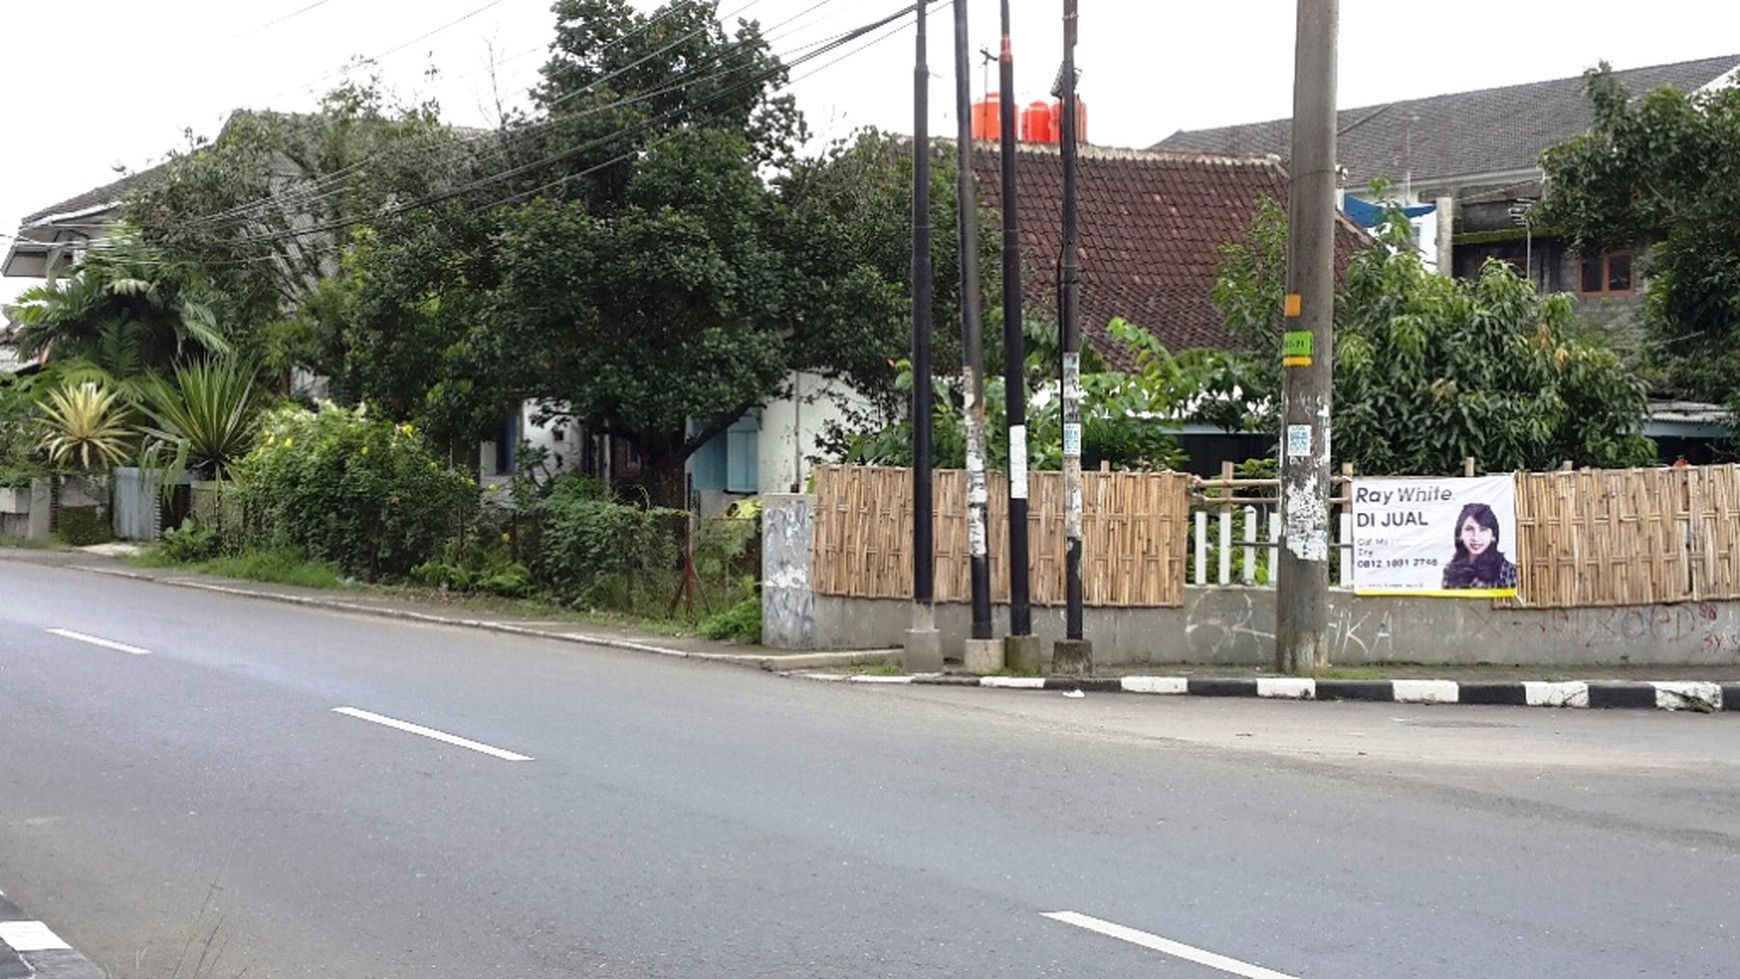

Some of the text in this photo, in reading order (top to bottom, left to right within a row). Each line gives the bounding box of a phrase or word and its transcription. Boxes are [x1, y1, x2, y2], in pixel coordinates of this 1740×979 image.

[1356, 487, 1394, 505] Ray
[1357, 511, 1429, 527] DI JUAL
[1357, 560, 1382, 568] 0812
